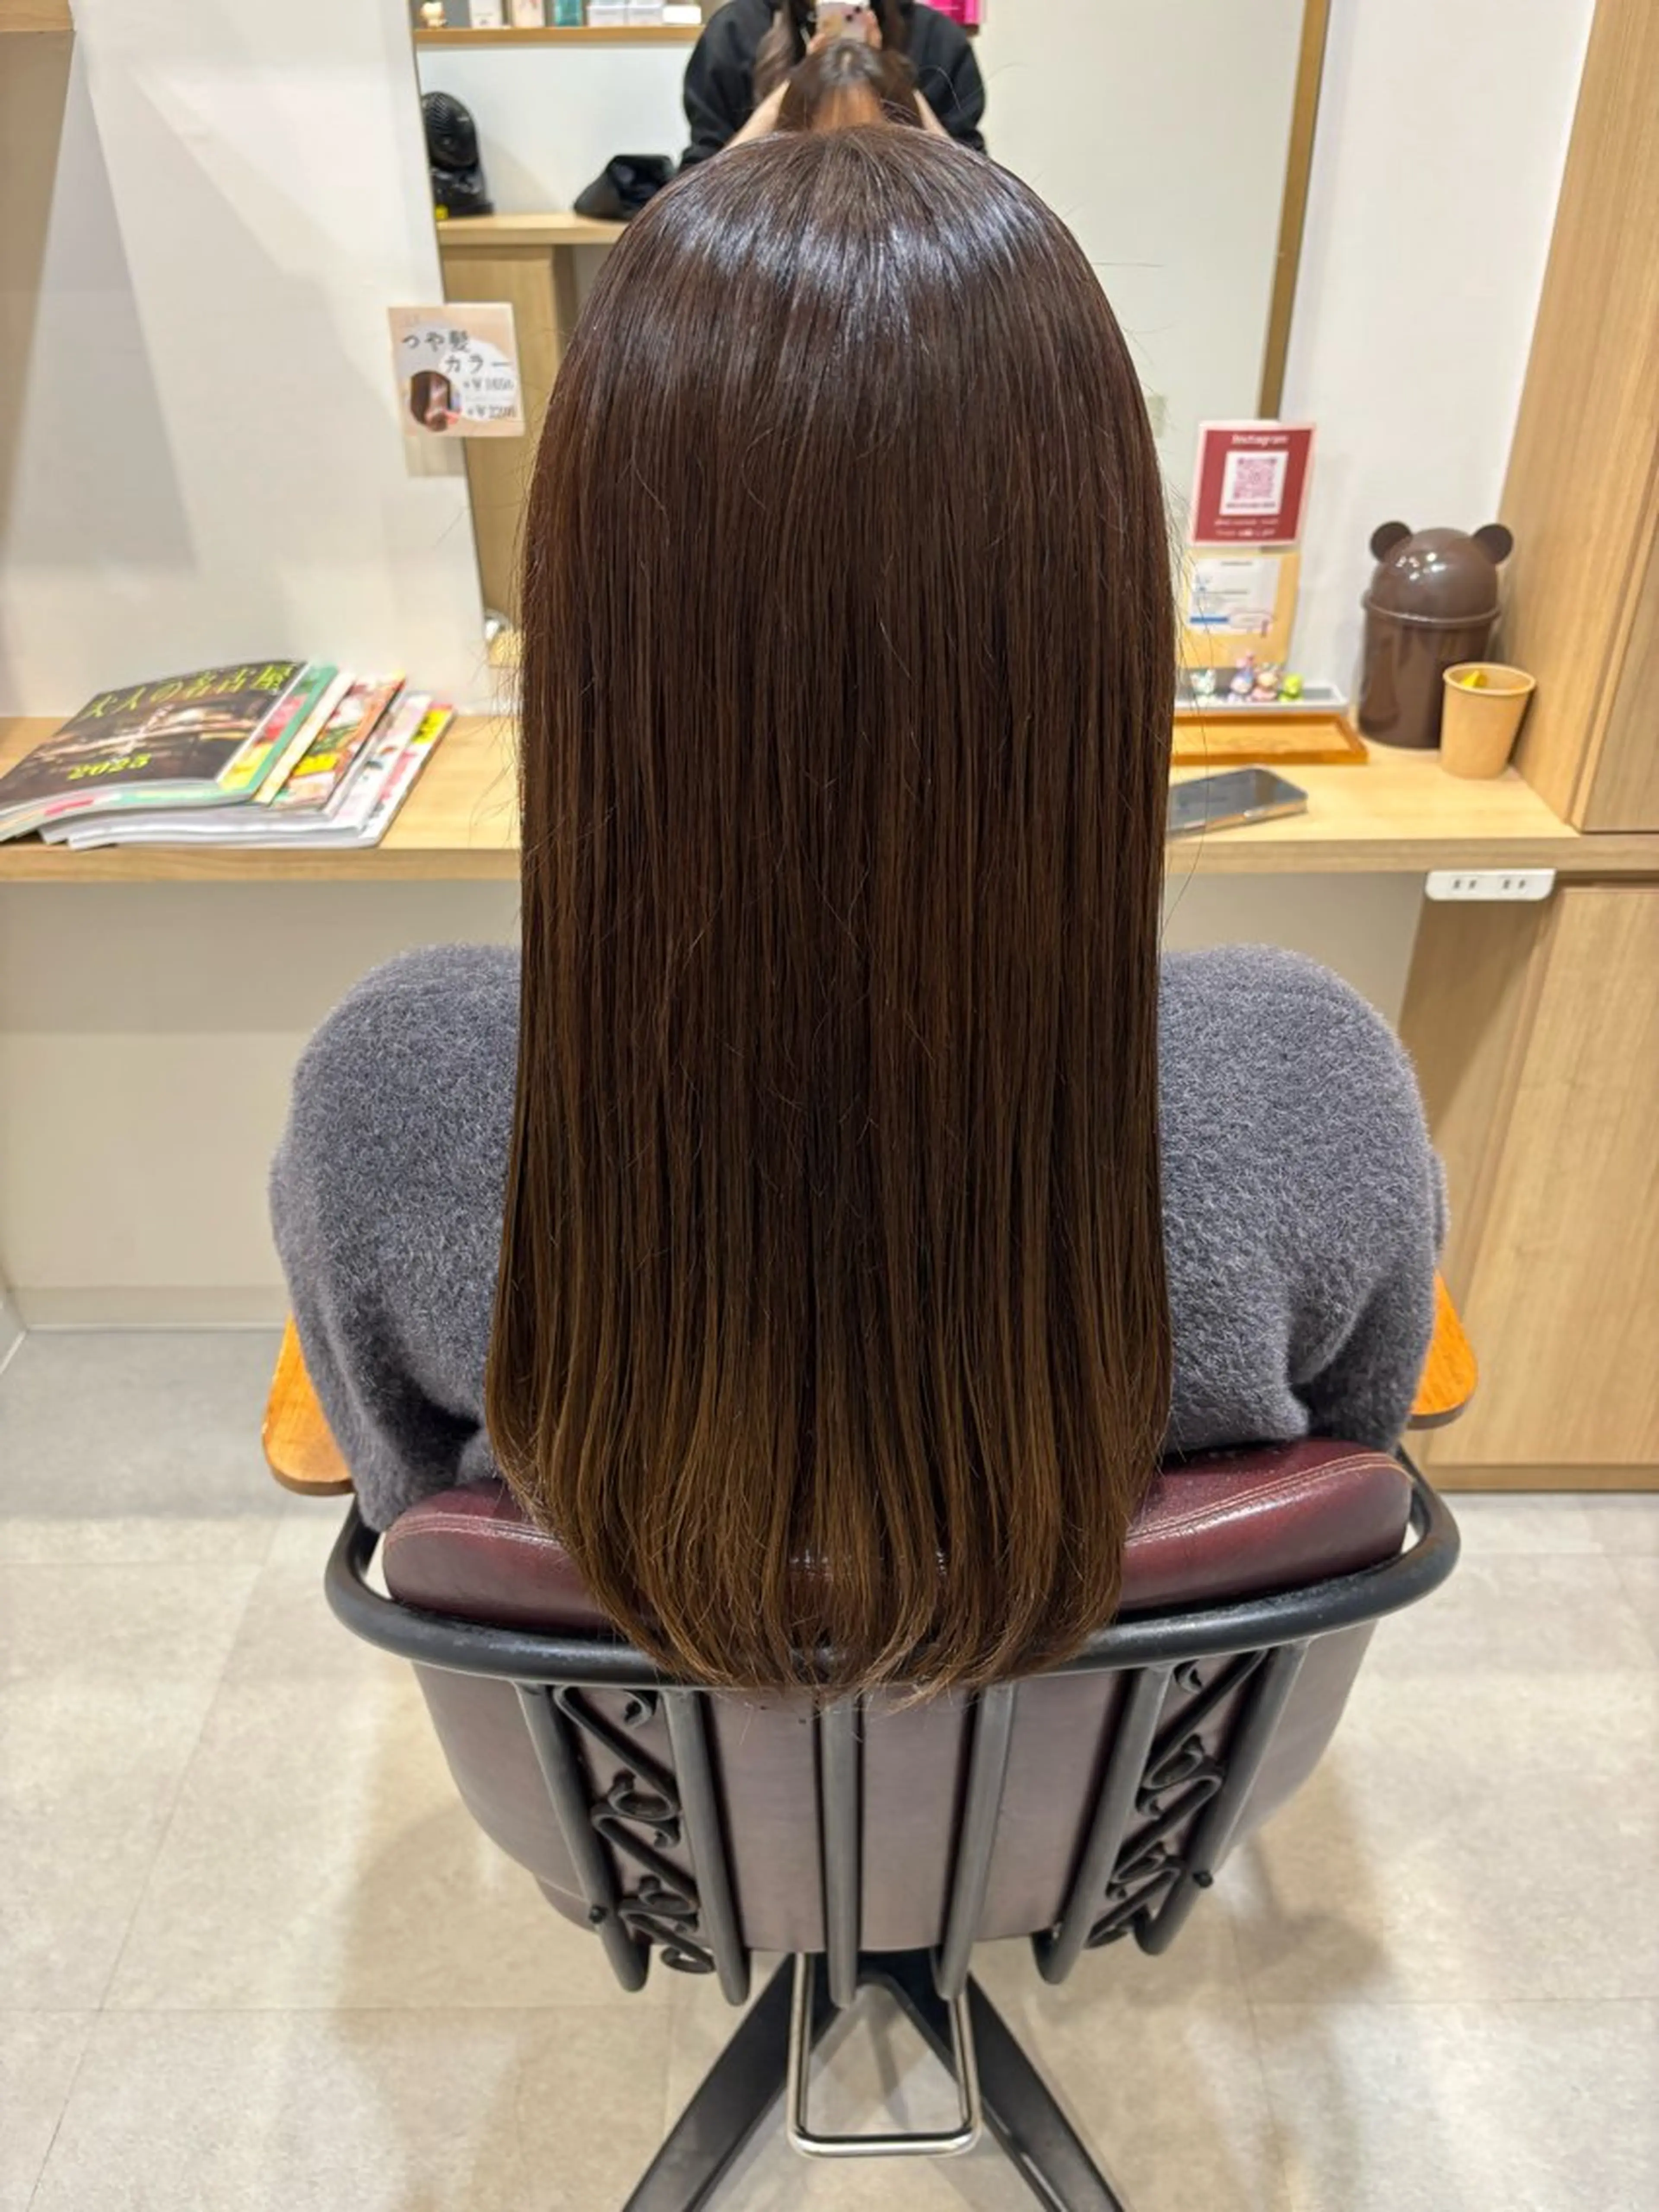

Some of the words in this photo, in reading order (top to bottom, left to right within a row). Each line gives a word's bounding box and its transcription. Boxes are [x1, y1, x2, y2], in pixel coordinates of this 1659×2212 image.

[401, 329, 470, 353] つや髪
[444, 353, 512, 375] カラー
